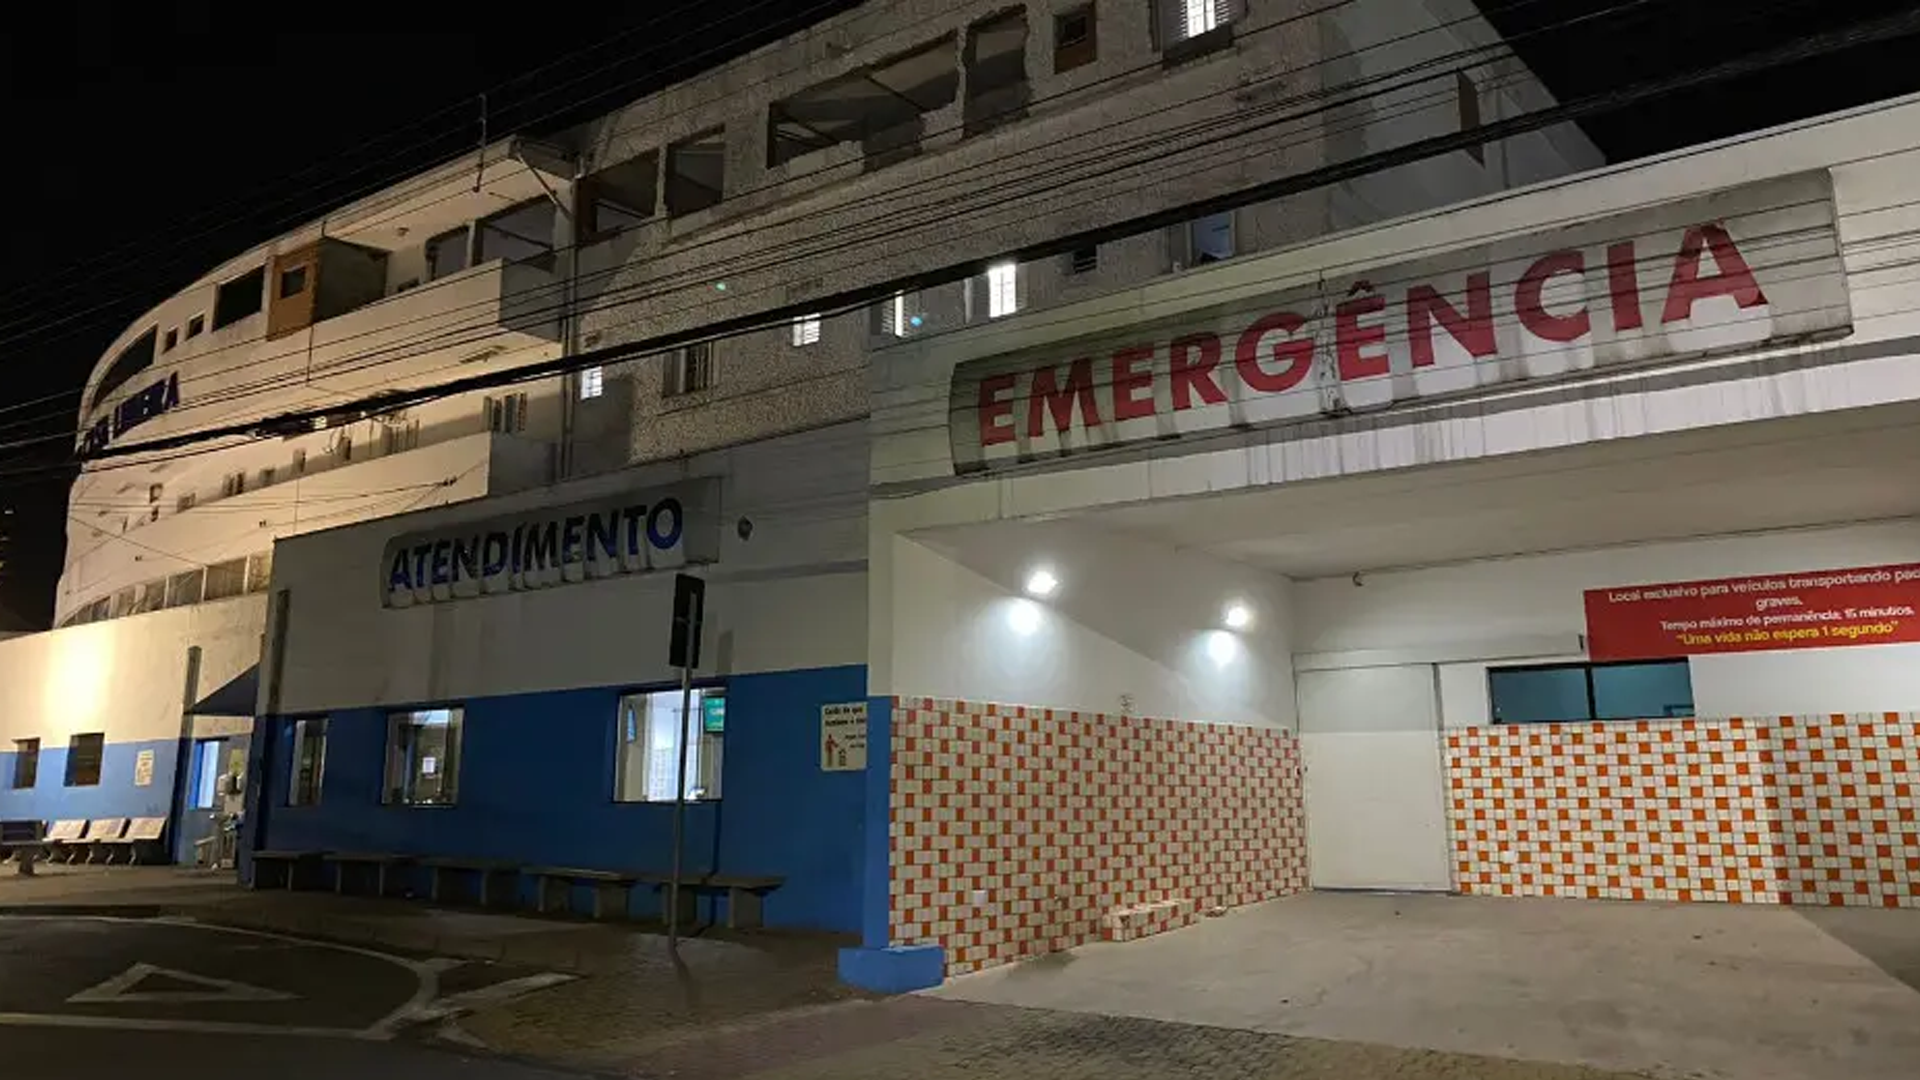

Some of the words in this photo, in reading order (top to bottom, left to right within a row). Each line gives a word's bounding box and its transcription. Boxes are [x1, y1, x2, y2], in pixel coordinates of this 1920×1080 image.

[977, 222, 1769, 446] EMERGÊNCIA
[389, 498, 684, 592] ATENDIMENTO
[1608, 589, 1641, 603] Local
[1643, 585, 1698, 599] exclusivo
[1700, 584, 1730, 600] para
[1731, 579, 1787, 593] veículos
[1788, 570, 1891, 588] transportando
[1661, 620, 1698, 632] Tempo
[1699, 616, 1744, 629] máximo
[1745, 615, 1762, 626] de
[1714, 631, 1743, 643] vida
[1744, 629, 1771, 642] não
[1773, 627, 1820, 641] espera
[1821, 626, 1829, 637] 1
